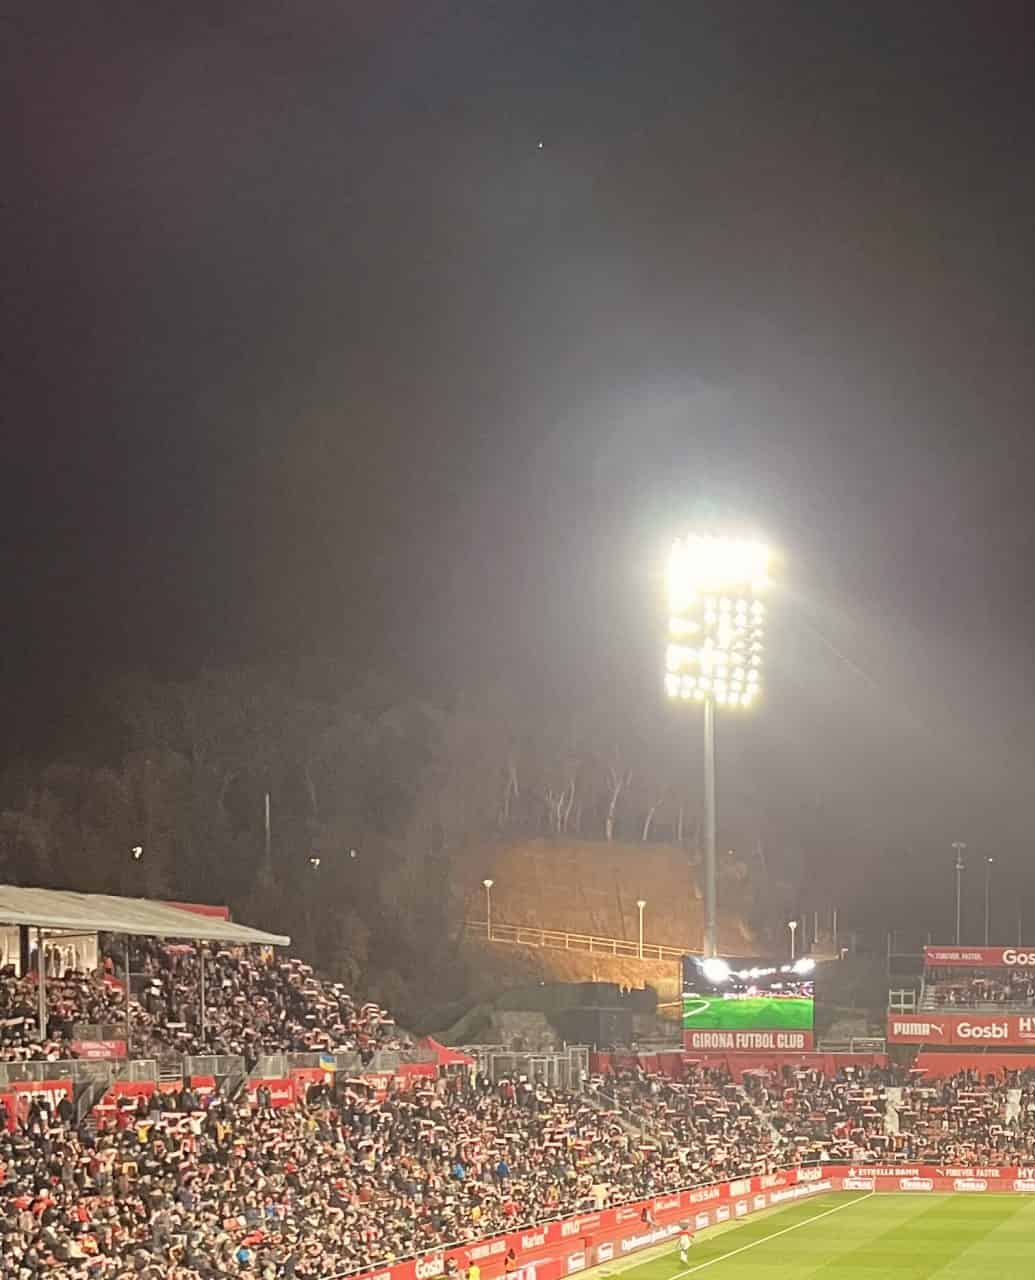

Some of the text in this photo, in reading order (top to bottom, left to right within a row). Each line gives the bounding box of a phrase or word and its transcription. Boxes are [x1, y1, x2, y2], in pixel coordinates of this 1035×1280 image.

[893, 1023, 930, 1036] PUMA
[956, 1022, 1008, 1039] Gosbi
[692, 1033, 804, 1049] GIRONA FUTBOL CLUB
